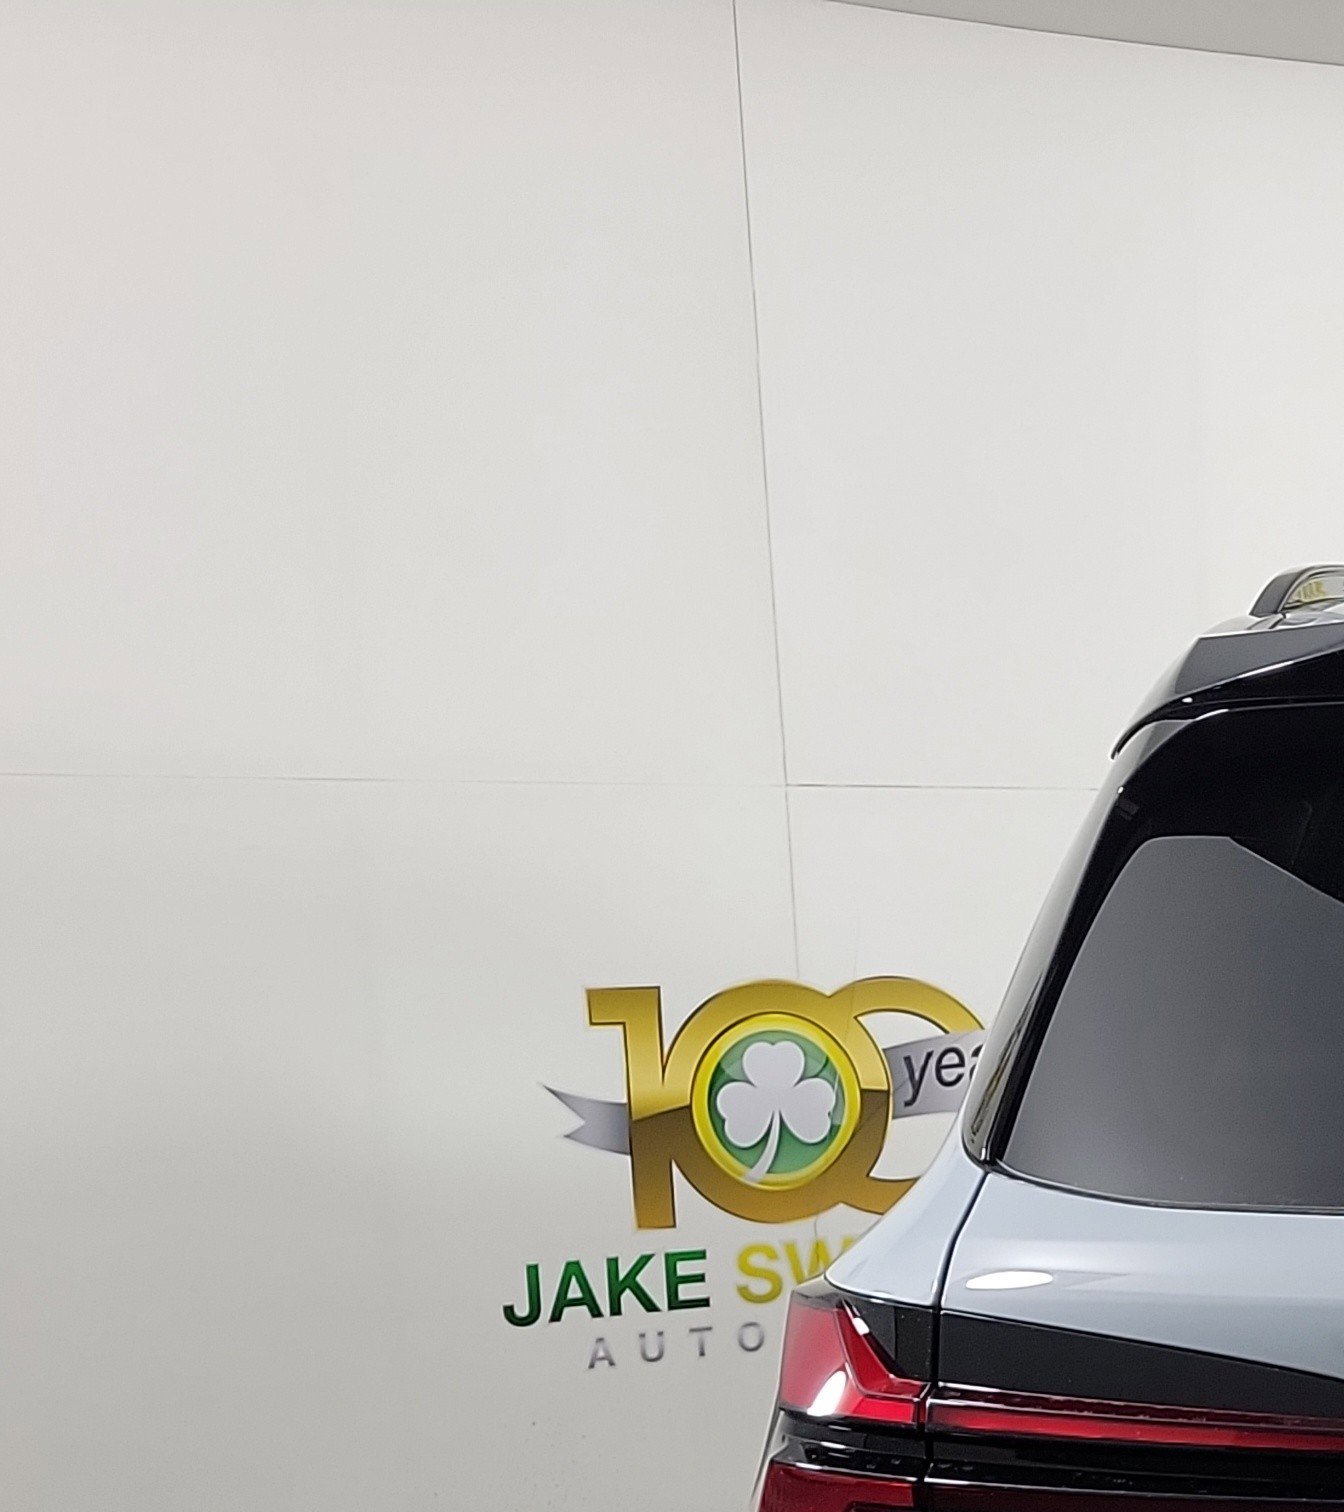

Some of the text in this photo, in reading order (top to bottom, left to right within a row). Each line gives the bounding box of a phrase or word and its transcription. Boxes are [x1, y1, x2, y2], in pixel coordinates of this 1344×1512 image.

[585, 976, 985, 1229] 100
[502, 1249, 711, 1327] JAKE
[588, 1321, 766, 1368] AUTO
